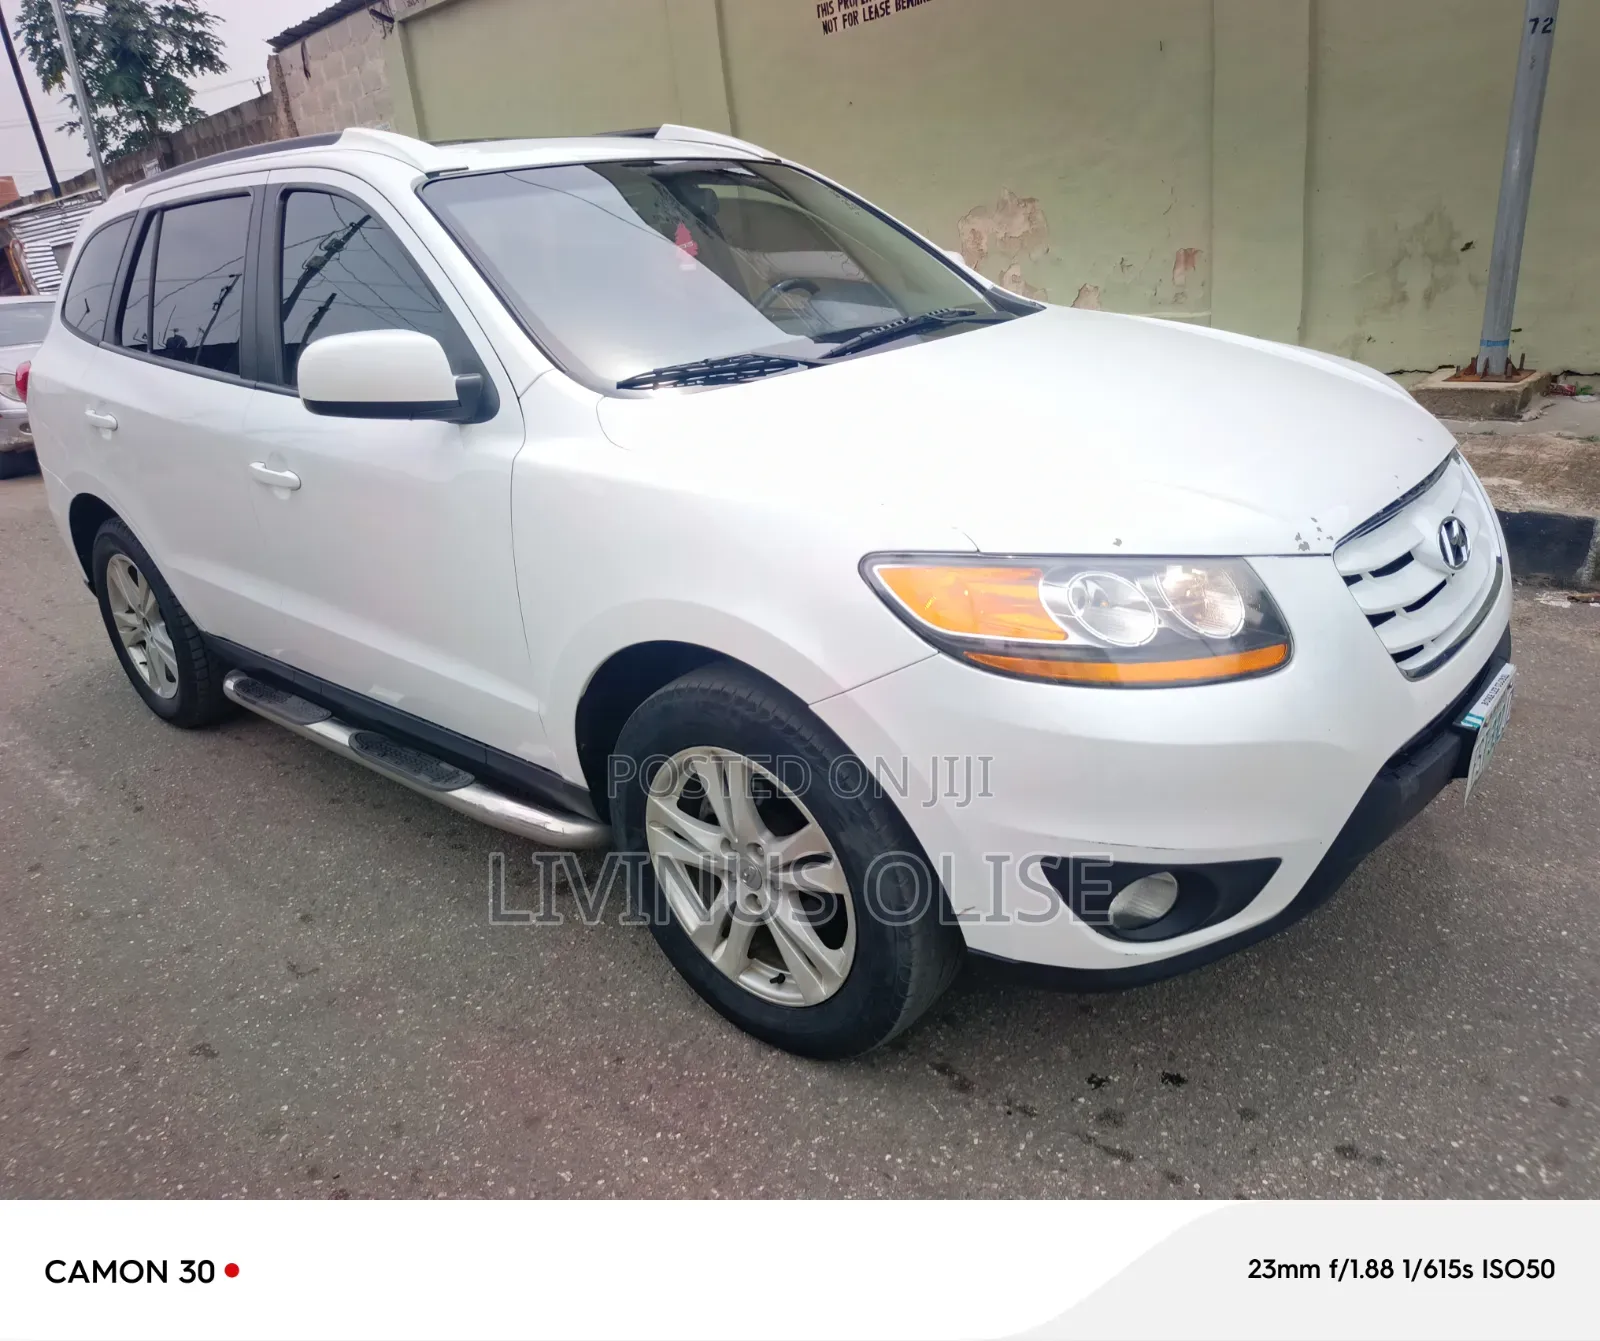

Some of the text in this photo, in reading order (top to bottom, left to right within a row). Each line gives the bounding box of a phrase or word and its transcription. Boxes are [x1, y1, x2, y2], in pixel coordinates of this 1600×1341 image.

[816, 0, 835, 18] THIS
[822, 16, 838, 35] NOT
[842, 10, 859, 29] FOR
[862, 0, 890, 22] LEASE
[1528, 16, 1554, 35] 72
